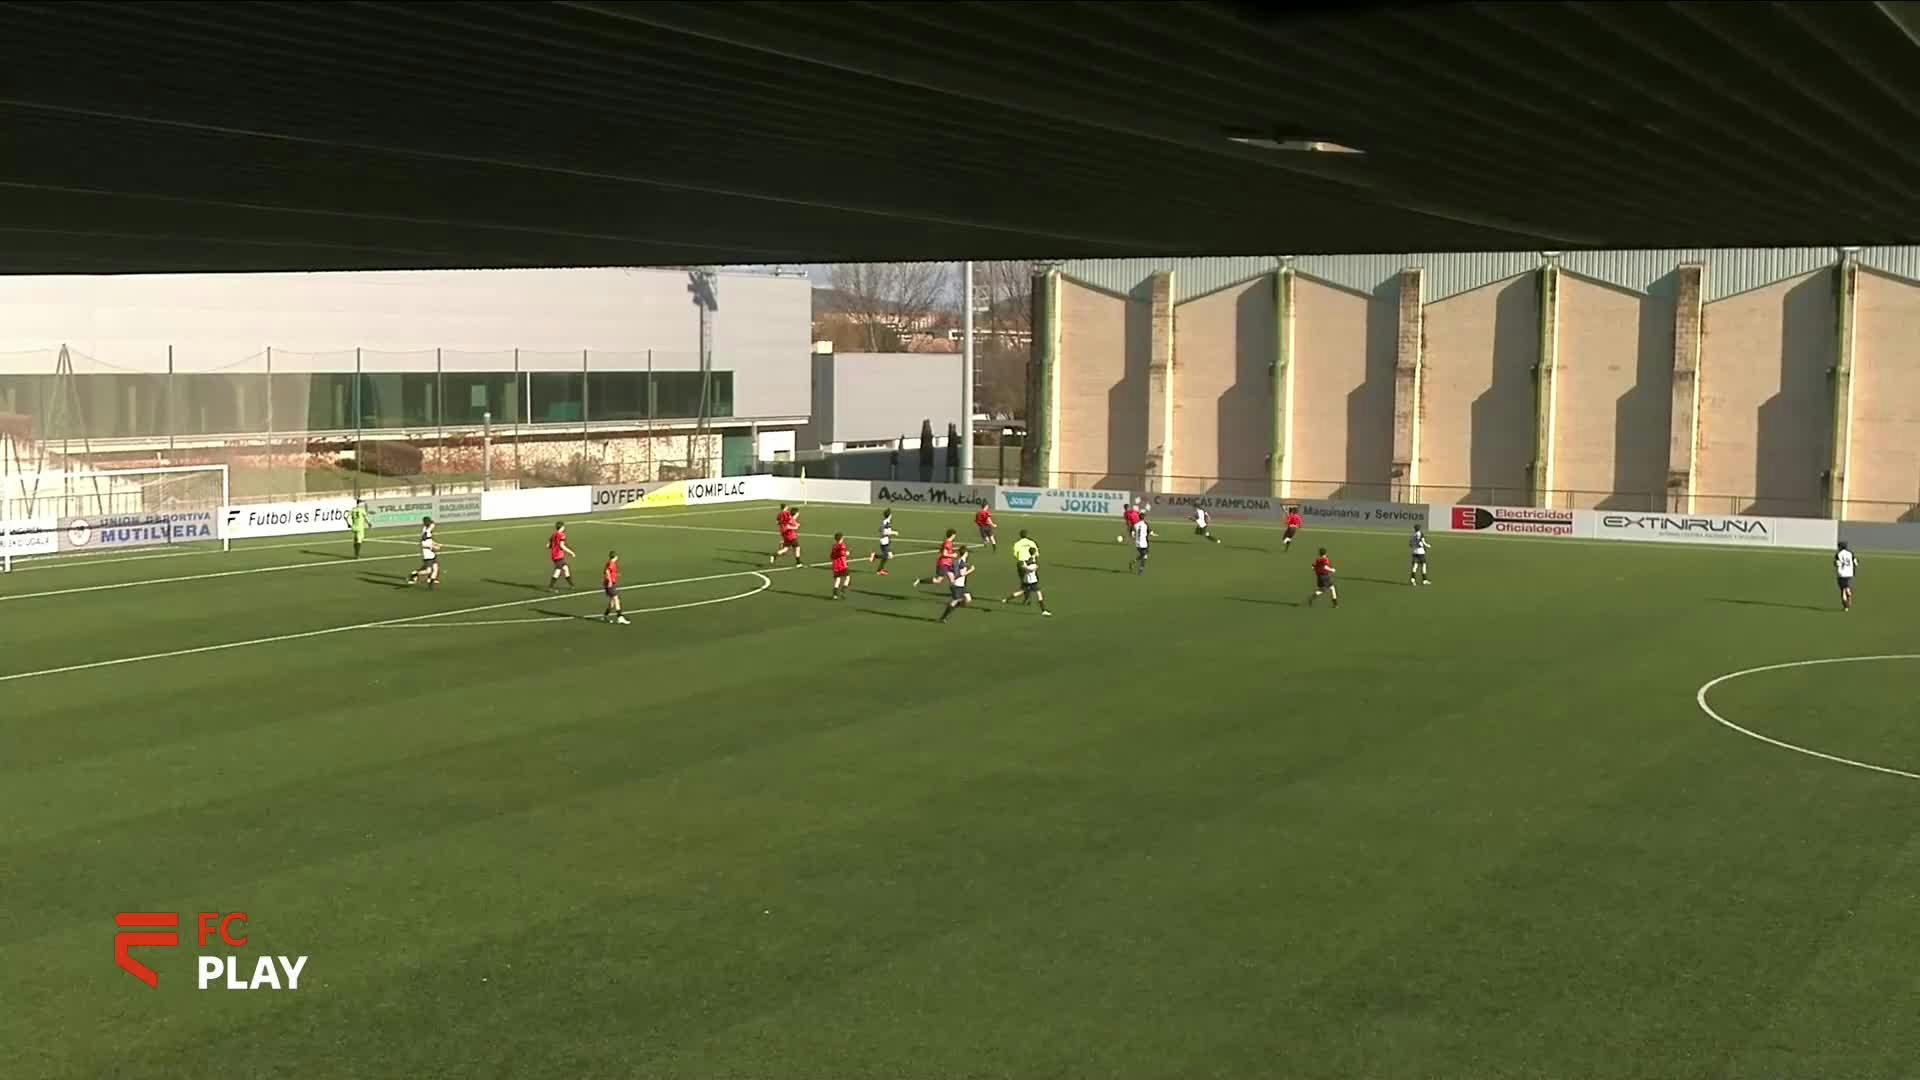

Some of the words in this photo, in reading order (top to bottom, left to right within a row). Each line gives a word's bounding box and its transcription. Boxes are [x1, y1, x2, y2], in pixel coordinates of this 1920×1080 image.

[592, 488, 645, 506] JOYFER
[688, 481, 745, 499] KOMIPLAC
[1215, 498, 1270, 510] PAMPLONA
[249, 510, 291, 526] Futbol
[295, 511, 310, 523] es
[314, 508, 351, 522] Futbo
[1303, 505, 1360, 519] Maquinaria
[1364, 510, 1371, 520] y
[1375, 509, 1425, 520] Servicios
[1495, 509, 1573, 519] Electricidad
[101, 524, 211, 542] MUTILVERA
[1495, 523, 1573, 535] Oficialdegui
